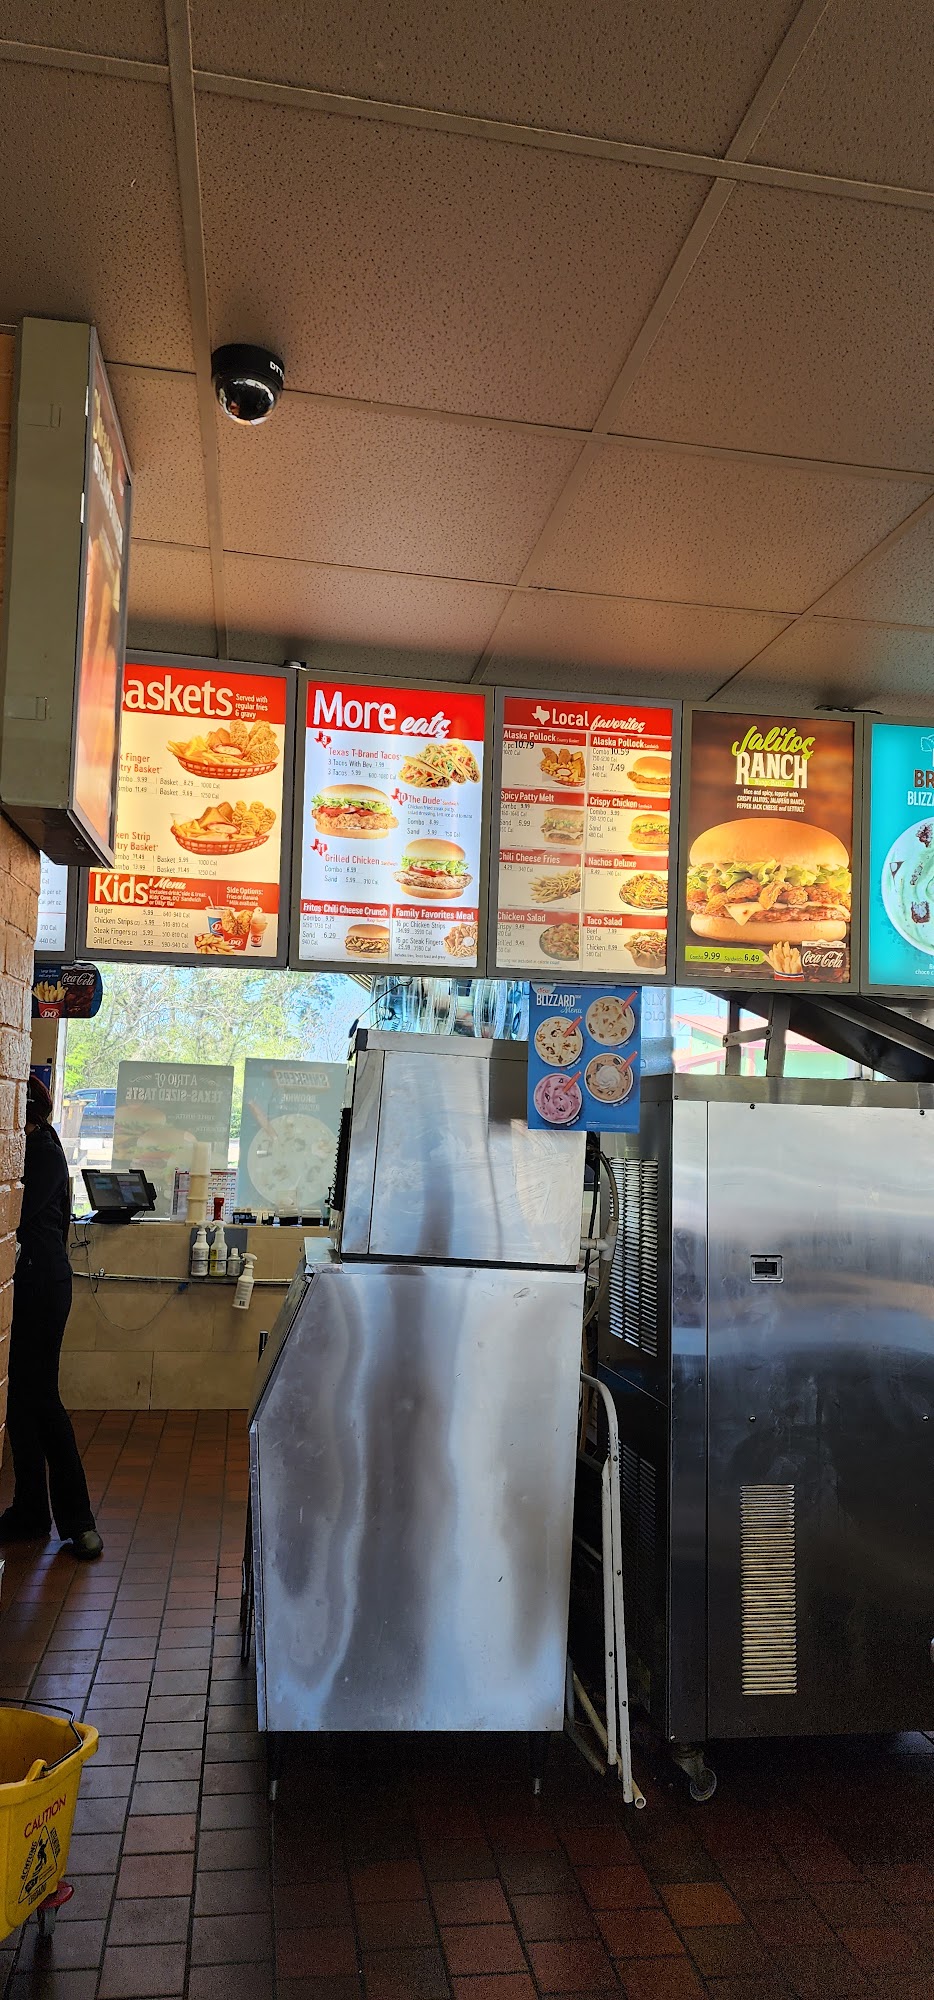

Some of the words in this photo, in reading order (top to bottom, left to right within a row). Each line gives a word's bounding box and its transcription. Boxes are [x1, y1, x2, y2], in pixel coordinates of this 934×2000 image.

[124, 674, 233, 717] askets
[235, 693, 255, 703] Served
[235, 702, 255, 711] regular
[240, 711, 256, 719] gravy
[313, 689, 397, 731] More
[400, 711, 451, 739] eats
[552, 709, 589, 727] Local
[590, 715, 646, 733] favorites
[322, 736, 328, 745] 9
[503, 731, 528, 740] Alaska
[529, 732, 556, 742] Pollock
[514, 741, 534, 749] 10.79
[593, 737, 616, 747] Alaska
[618, 738, 644, 749] Pollock
[731, 725, 816, 761] Jalitos
[125, 753, 150, 763] Finger
[329, 747, 349, 757] Texas
[352, 749, 378, 759] T-Brand
[380, 751, 400, 761] Tacos
[328, 758, 331, 766] 3
[332, 759, 348, 767] Tacos
[610, 763, 625, 772] 7.49
[134, 764, 161, 774] Basket
[332, 769, 348, 777] Tacos
[735, 751, 808, 789] RANCH
[160, 778, 179, 786] Basket
[159, 788, 178, 796] Basket
[500, 791, 519, 802] Spicy
[519, 792, 538, 803] Patty
[539, 793, 554, 803] Melt
[408, 794, 421, 804] The
[422, 795, 440, 805] Dude
[590, 797, 610, 809] Crispy
[612, 798, 638, 809] Chicken
[589, 808, 607, 816] Combo
[737, 802, 752, 810] PEPPER
[752, 803, 763, 811] JACK
[787, 805, 804, 813] LETTUCE
[407, 818, 425, 826] Combo
[518, 819, 530, 827] 5.99
[132, 832, 150, 841] Strip
[131, 843, 157, 852] Basket
[157, 856, 175, 864] Basket
[325, 854, 349, 863] Grilled
[352, 855, 380, 866] Chicken
[515, 852, 541, 863] Cheese
[543, 854, 560, 864] Fries
[588, 857, 612, 867] Nachos
[613, 858, 636, 868] Deluxe
[156, 866, 175, 874] Basket
[324, 865, 343, 873] Combo
[153, 878, 187, 890] Menu
[324, 875, 337, 883] Sand
[226, 887, 239, 895] Side
[239, 887, 263, 896] Options:
[94, 906, 113, 914] Burger
[303, 903, 321, 912] Fritos
[323, 903, 338, 913] Chili
[339, 905, 363, 915] Cheese
[364, 907, 388, 916] Crunch
[395, 907, 419, 920] Family
[421, 909, 455, 920] Favorites
[456, 912, 474, 921] Meal
[94, 917, 116, 925] Chicken
[117, 918, 133, 926] Strips
[302, 914, 321, 922] Combo
[497, 911, 525, 921] Chicken
[526, 913, 546, 922] Salad
[587, 916, 603, 925] Taco
[603, 916, 623, 926] Salad
[410, 920, 430, 929] Chicken
[431, 921, 446, 930] Strips
[94, 927, 110, 935] Steak
[110, 927, 131, 936] Fingers
[302, 931, 315, 939] Sand
[93, 937, 112, 945] Grilled
[113, 938, 133, 946] Cheese
[410, 937, 425, 945] Steak
[425, 938, 444, 947] Fingers
[586, 943, 605, 951] Chicken
[703, 952, 721, 960] 9.99
[744, 954, 760, 963] 6.49
[802, 950, 843, 968] Coca-Cola
[61, 972, 95, 986] Coca-Cola
[536, 994, 575, 1007] BLIZZARD
[42, 1010, 57, 1018] DQ
[560, 1006, 583, 1014] Menu
[24, 1794, 67, 1838] CAUTION
